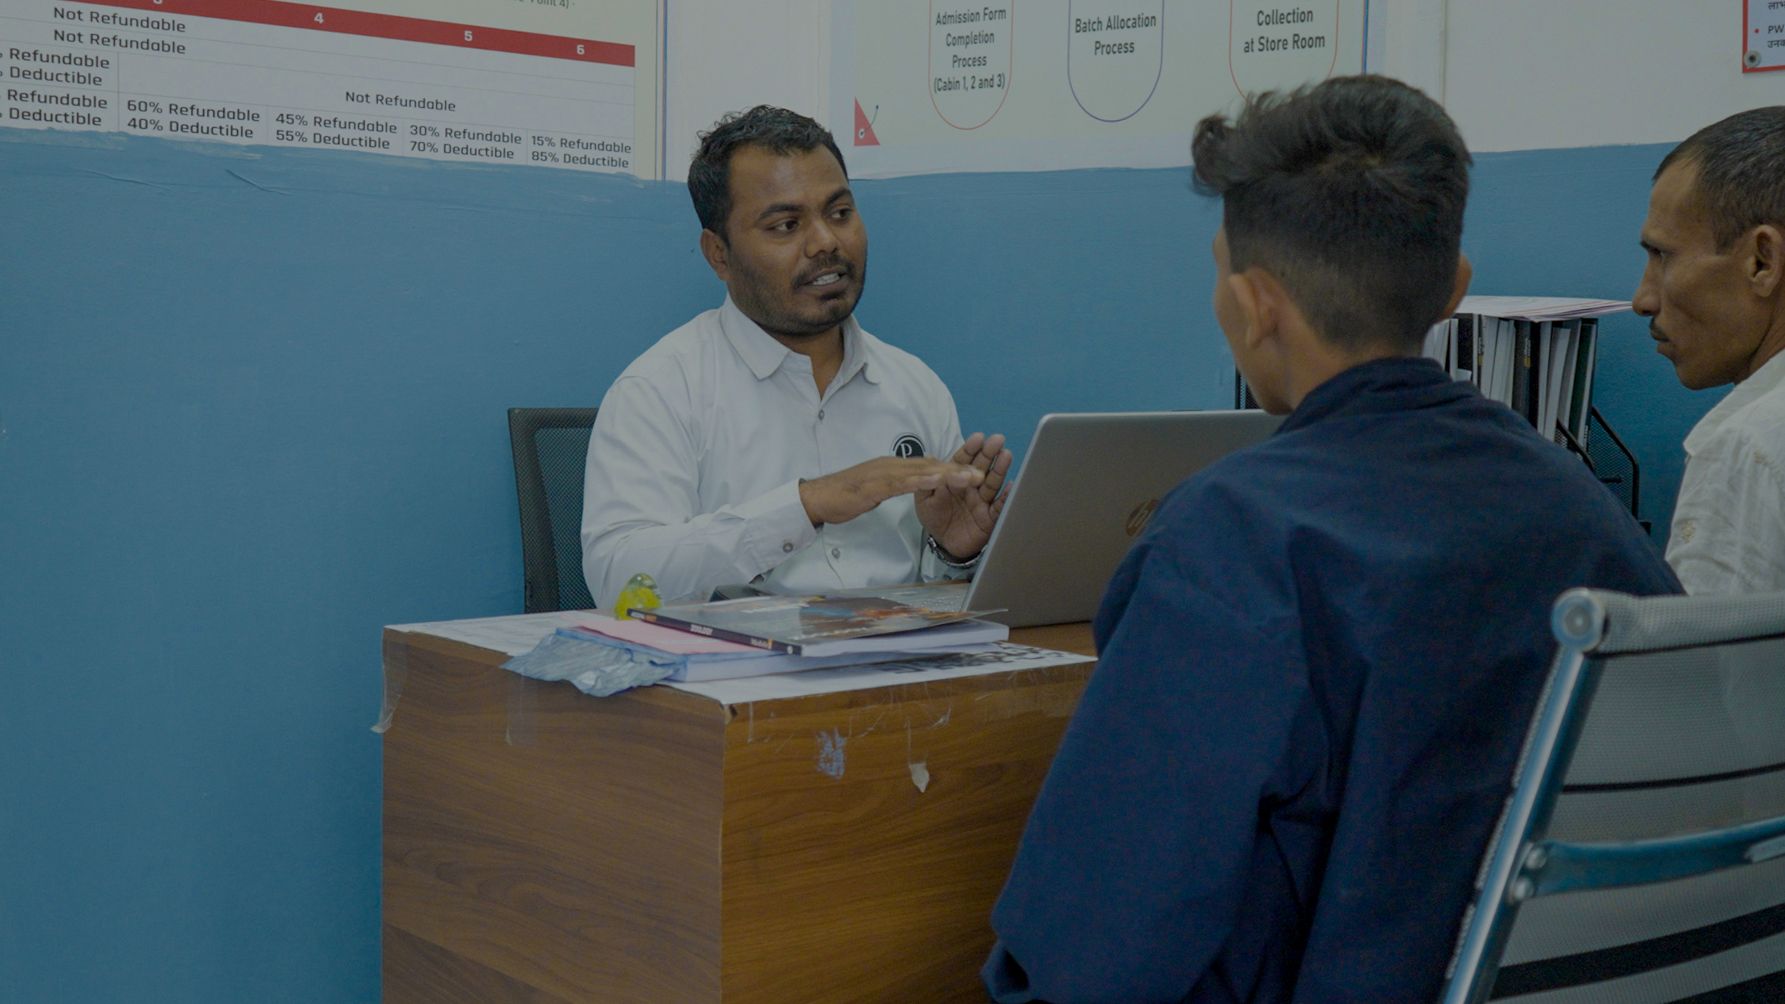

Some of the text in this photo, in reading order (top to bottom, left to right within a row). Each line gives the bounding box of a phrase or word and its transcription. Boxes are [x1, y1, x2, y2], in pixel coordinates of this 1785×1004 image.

[54, 7, 185, 32] Not Refundable
[314, 13, 324, 23] 4
[936, 7, 1006, 25] Admission Form
[1075, 13, 1156, 33] Batch Allocation
[1257, 8, 1313, 26] Collection
[54, 30, 185, 54] Not Refundable
[465, 31, 472, 41] 5
[946, 31, 994, 48] Completion
[1244, 34, 1325, 53] at Store Room
[577, 45, 584, 55] 6
[1095, 41, 1134, 55] Process
[10, 48, 109, 69] Refundable
[953, 55, 987, 68] Process
[10, 66, 102, 86] Deductible
[934, 78, 960, 93] (Cabin
[971, 76, 976, 89] 2
[978, 75, 994, 88] and
[997, 73, 1005, 89] 3)
[8, 89, 107, 109] Refundable
[346, 92, 455, 111] Not Refundable
[10, 108, 101, 126] Deductible
[128, 100, 260, 121] 60% Refundable
[128, 118, 253, 138] 40% Deductible
[276, 114, 397, 136] 45% Refundable
[410, 125, 521, 144] 30% Refundable
[276, 130, 390, 149] 55% Deductible
[532, 136, 631, 153] 15% Refundable
[411, 141, 514, 159] 70% Deductible
[532, 151, 629, 168] 85% Deductible
